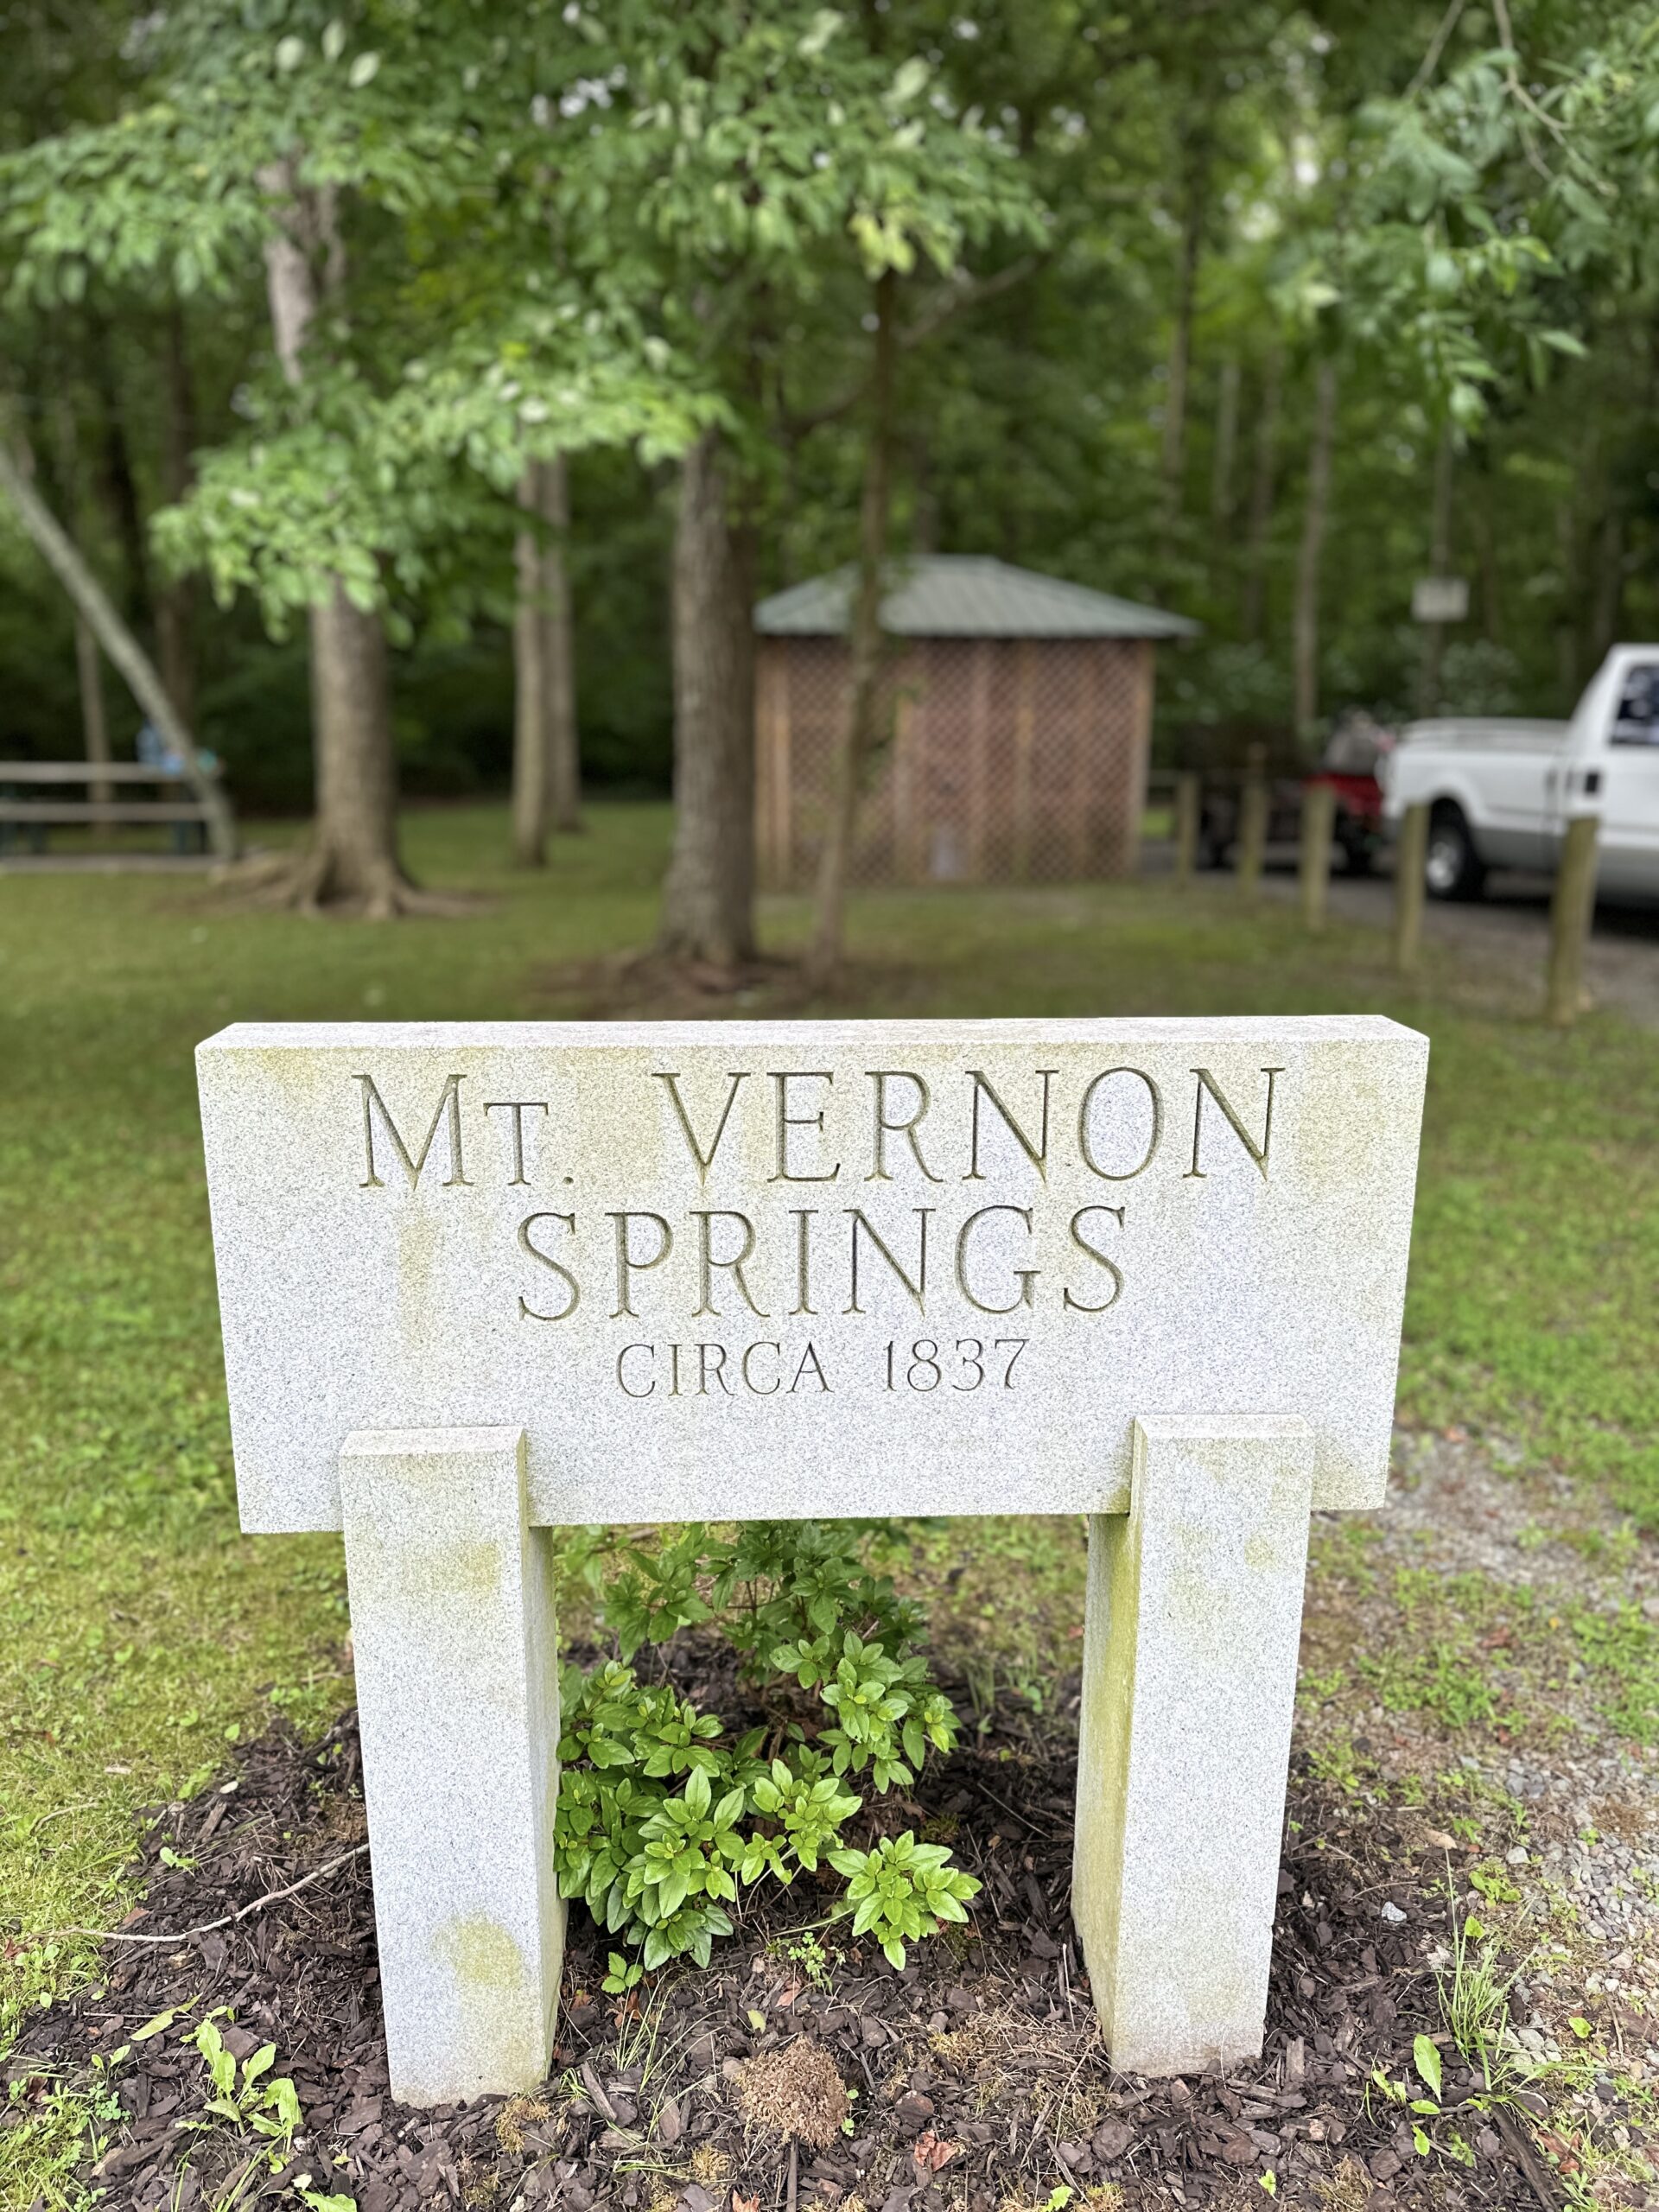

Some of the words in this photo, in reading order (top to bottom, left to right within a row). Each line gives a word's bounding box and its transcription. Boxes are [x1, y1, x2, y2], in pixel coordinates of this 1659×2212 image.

[652, 1066, 1285, 1187] VERNON
[517, 1205, 1128, 1321] SPRINGS
[617, 1342, 833, 1398] CIRCA
[882, 1338, 1033, 1393] 1837
